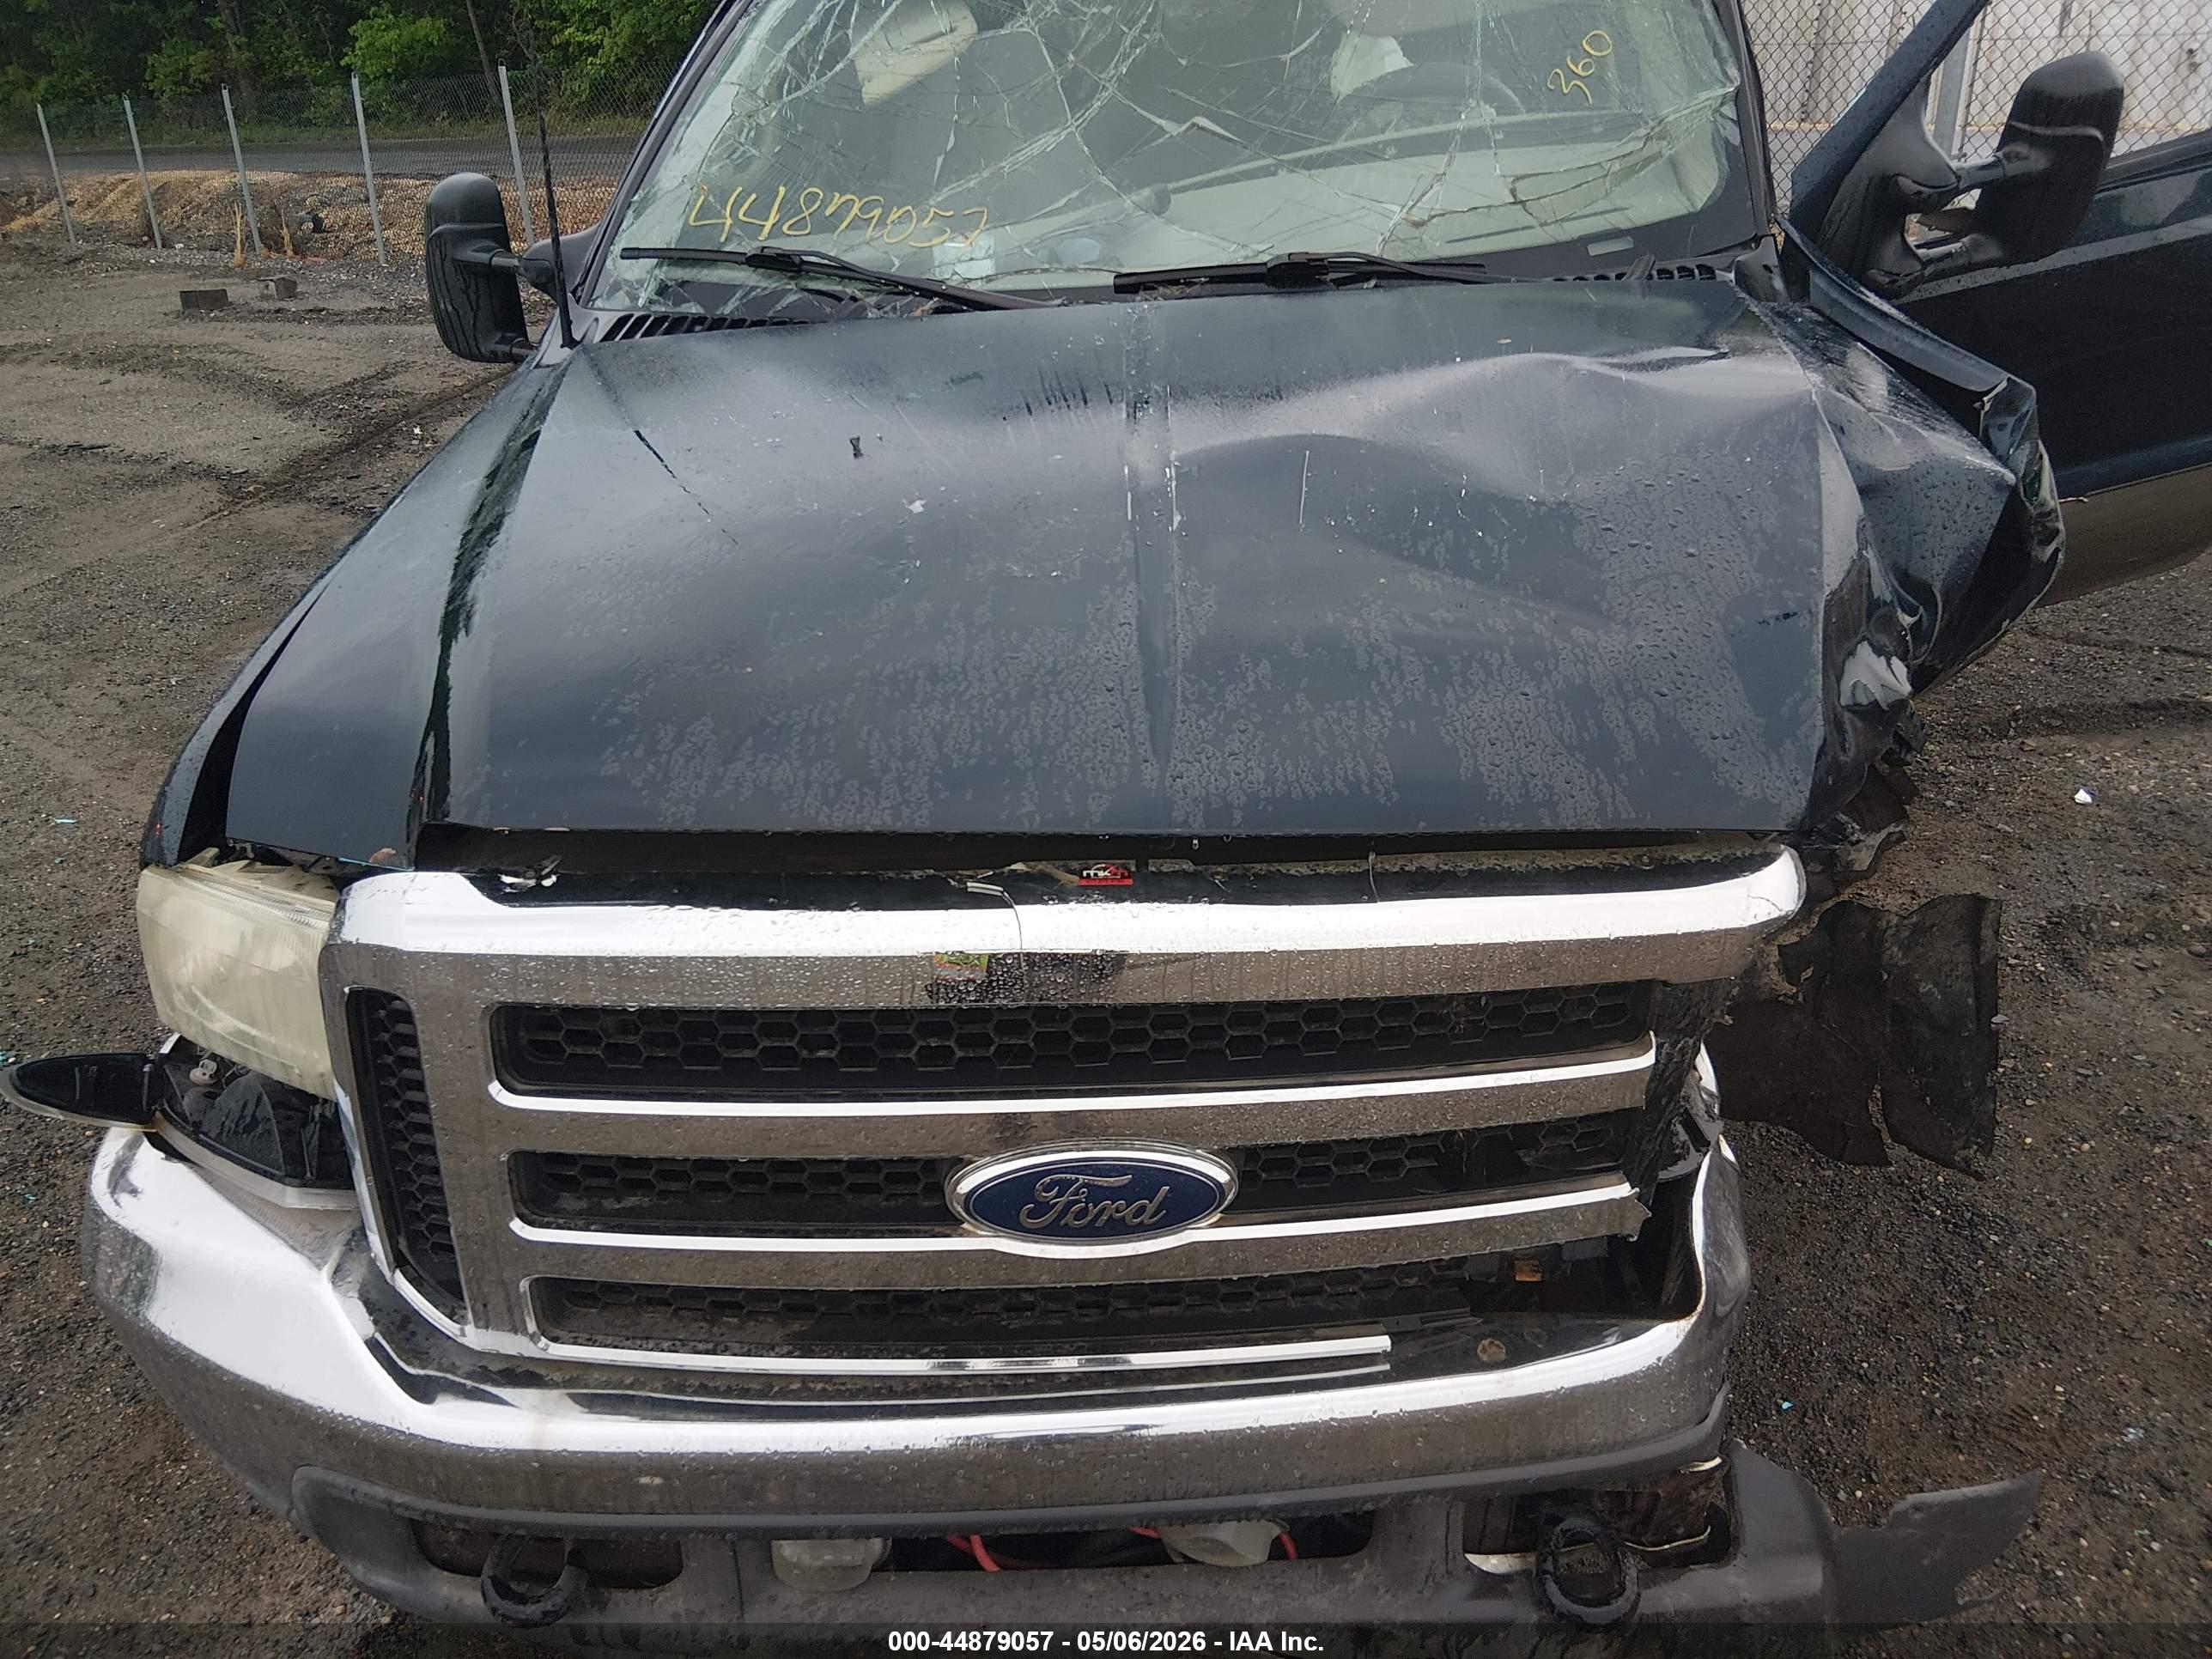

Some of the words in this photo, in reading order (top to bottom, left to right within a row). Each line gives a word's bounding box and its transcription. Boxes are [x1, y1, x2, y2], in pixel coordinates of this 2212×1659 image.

[1547, 30, 1613, 104] 360
[689, 185, 989, 248] 44879057
[1019, 1174, 1170, 1229] Ford
